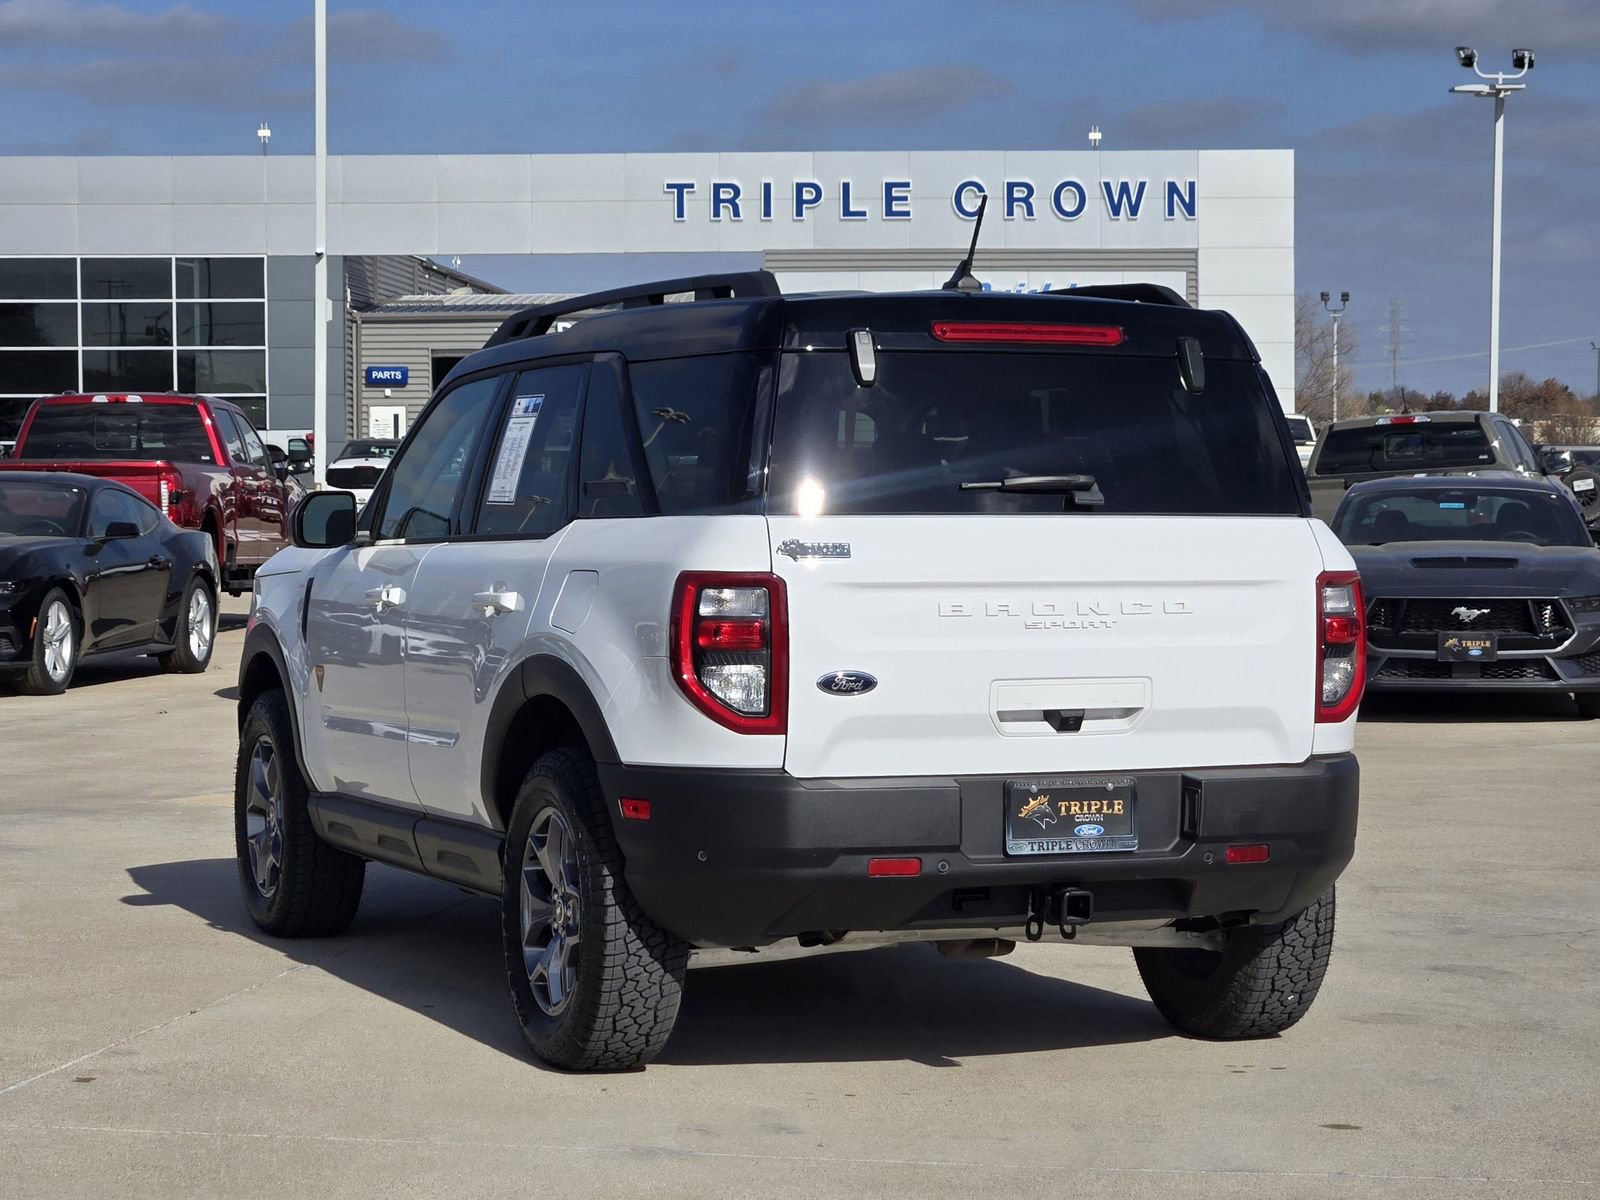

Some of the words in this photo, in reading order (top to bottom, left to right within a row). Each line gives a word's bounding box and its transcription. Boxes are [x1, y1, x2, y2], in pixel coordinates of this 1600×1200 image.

[664, 180, 913, 221] TRIPLE
[952, 178, 1198, 220] CROWN
[371, 370, 402, 380] PARTS
[937, 600, 1194, 618] BRONCO
[1024, 619, 1118, 630] SPORT
[1461, 640, 1491, 648] TRIPLE
[1057, 799, 1124, 817] TRIPLE
[1074, 813, 1104, 822] CROWN
[1028, 840, 1073, 851] TRIPLE
[1074, 838, 1115, 850] CROWN
